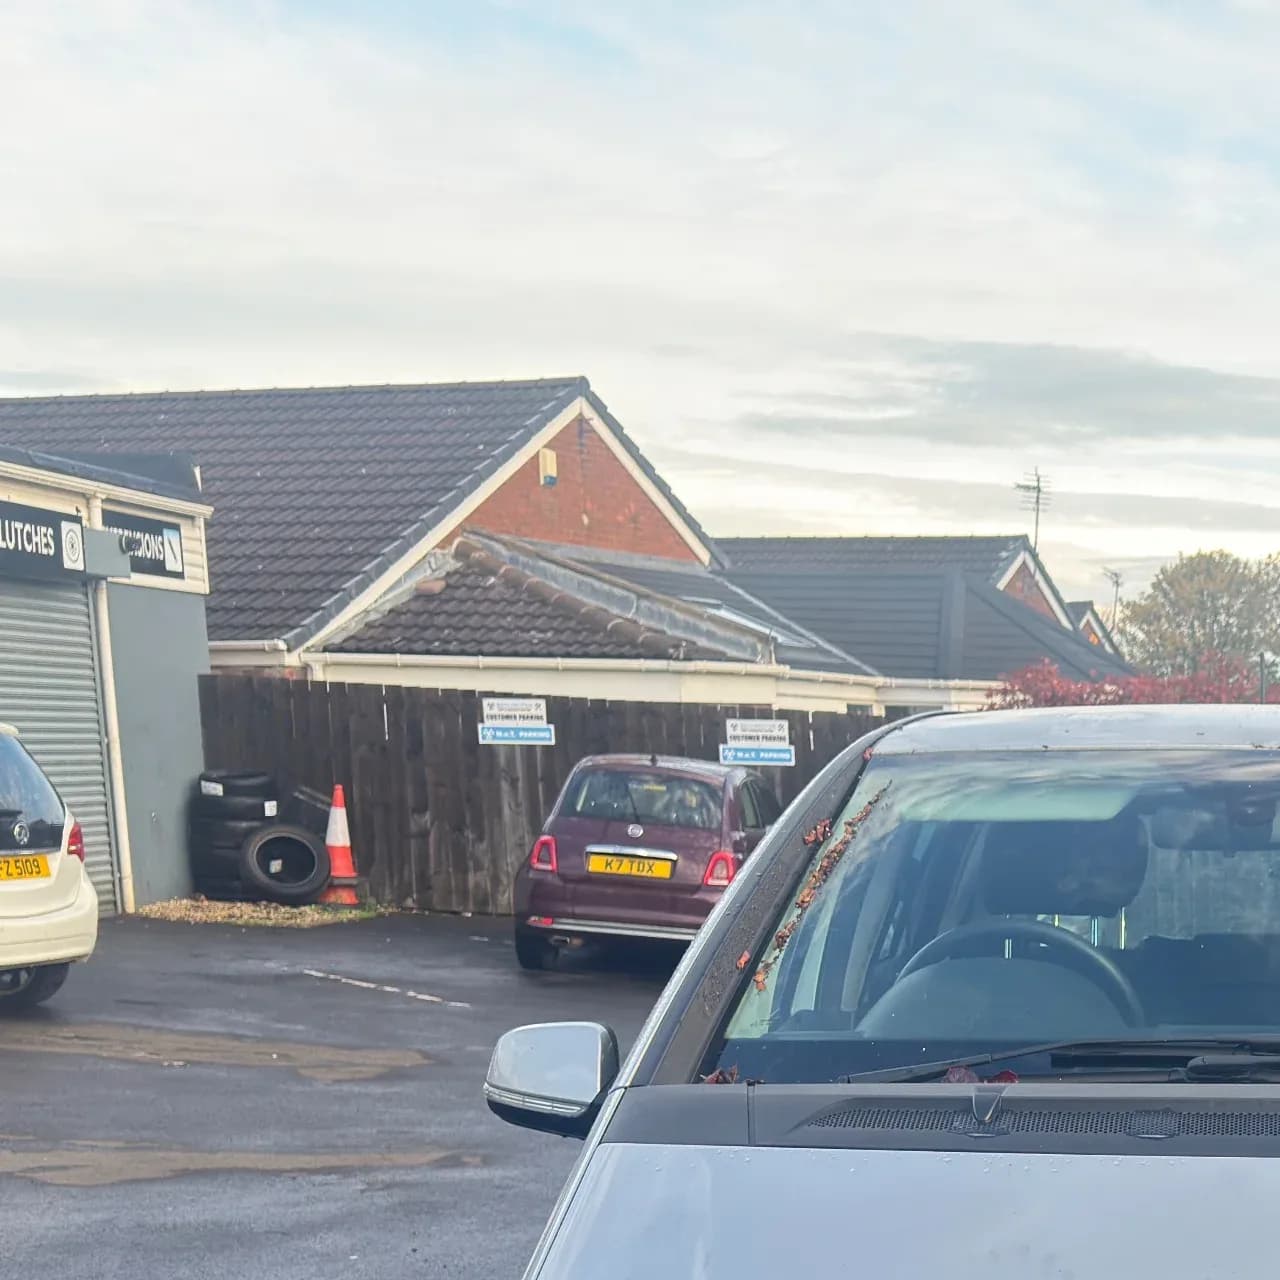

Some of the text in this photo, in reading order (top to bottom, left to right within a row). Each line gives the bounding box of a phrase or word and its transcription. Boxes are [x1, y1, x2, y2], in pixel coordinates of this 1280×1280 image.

[729, 735, 787, 744] CUSTOMER PARKING
[14, 858, 42, 876] 5109
[604, 858, 624, 871] K7
